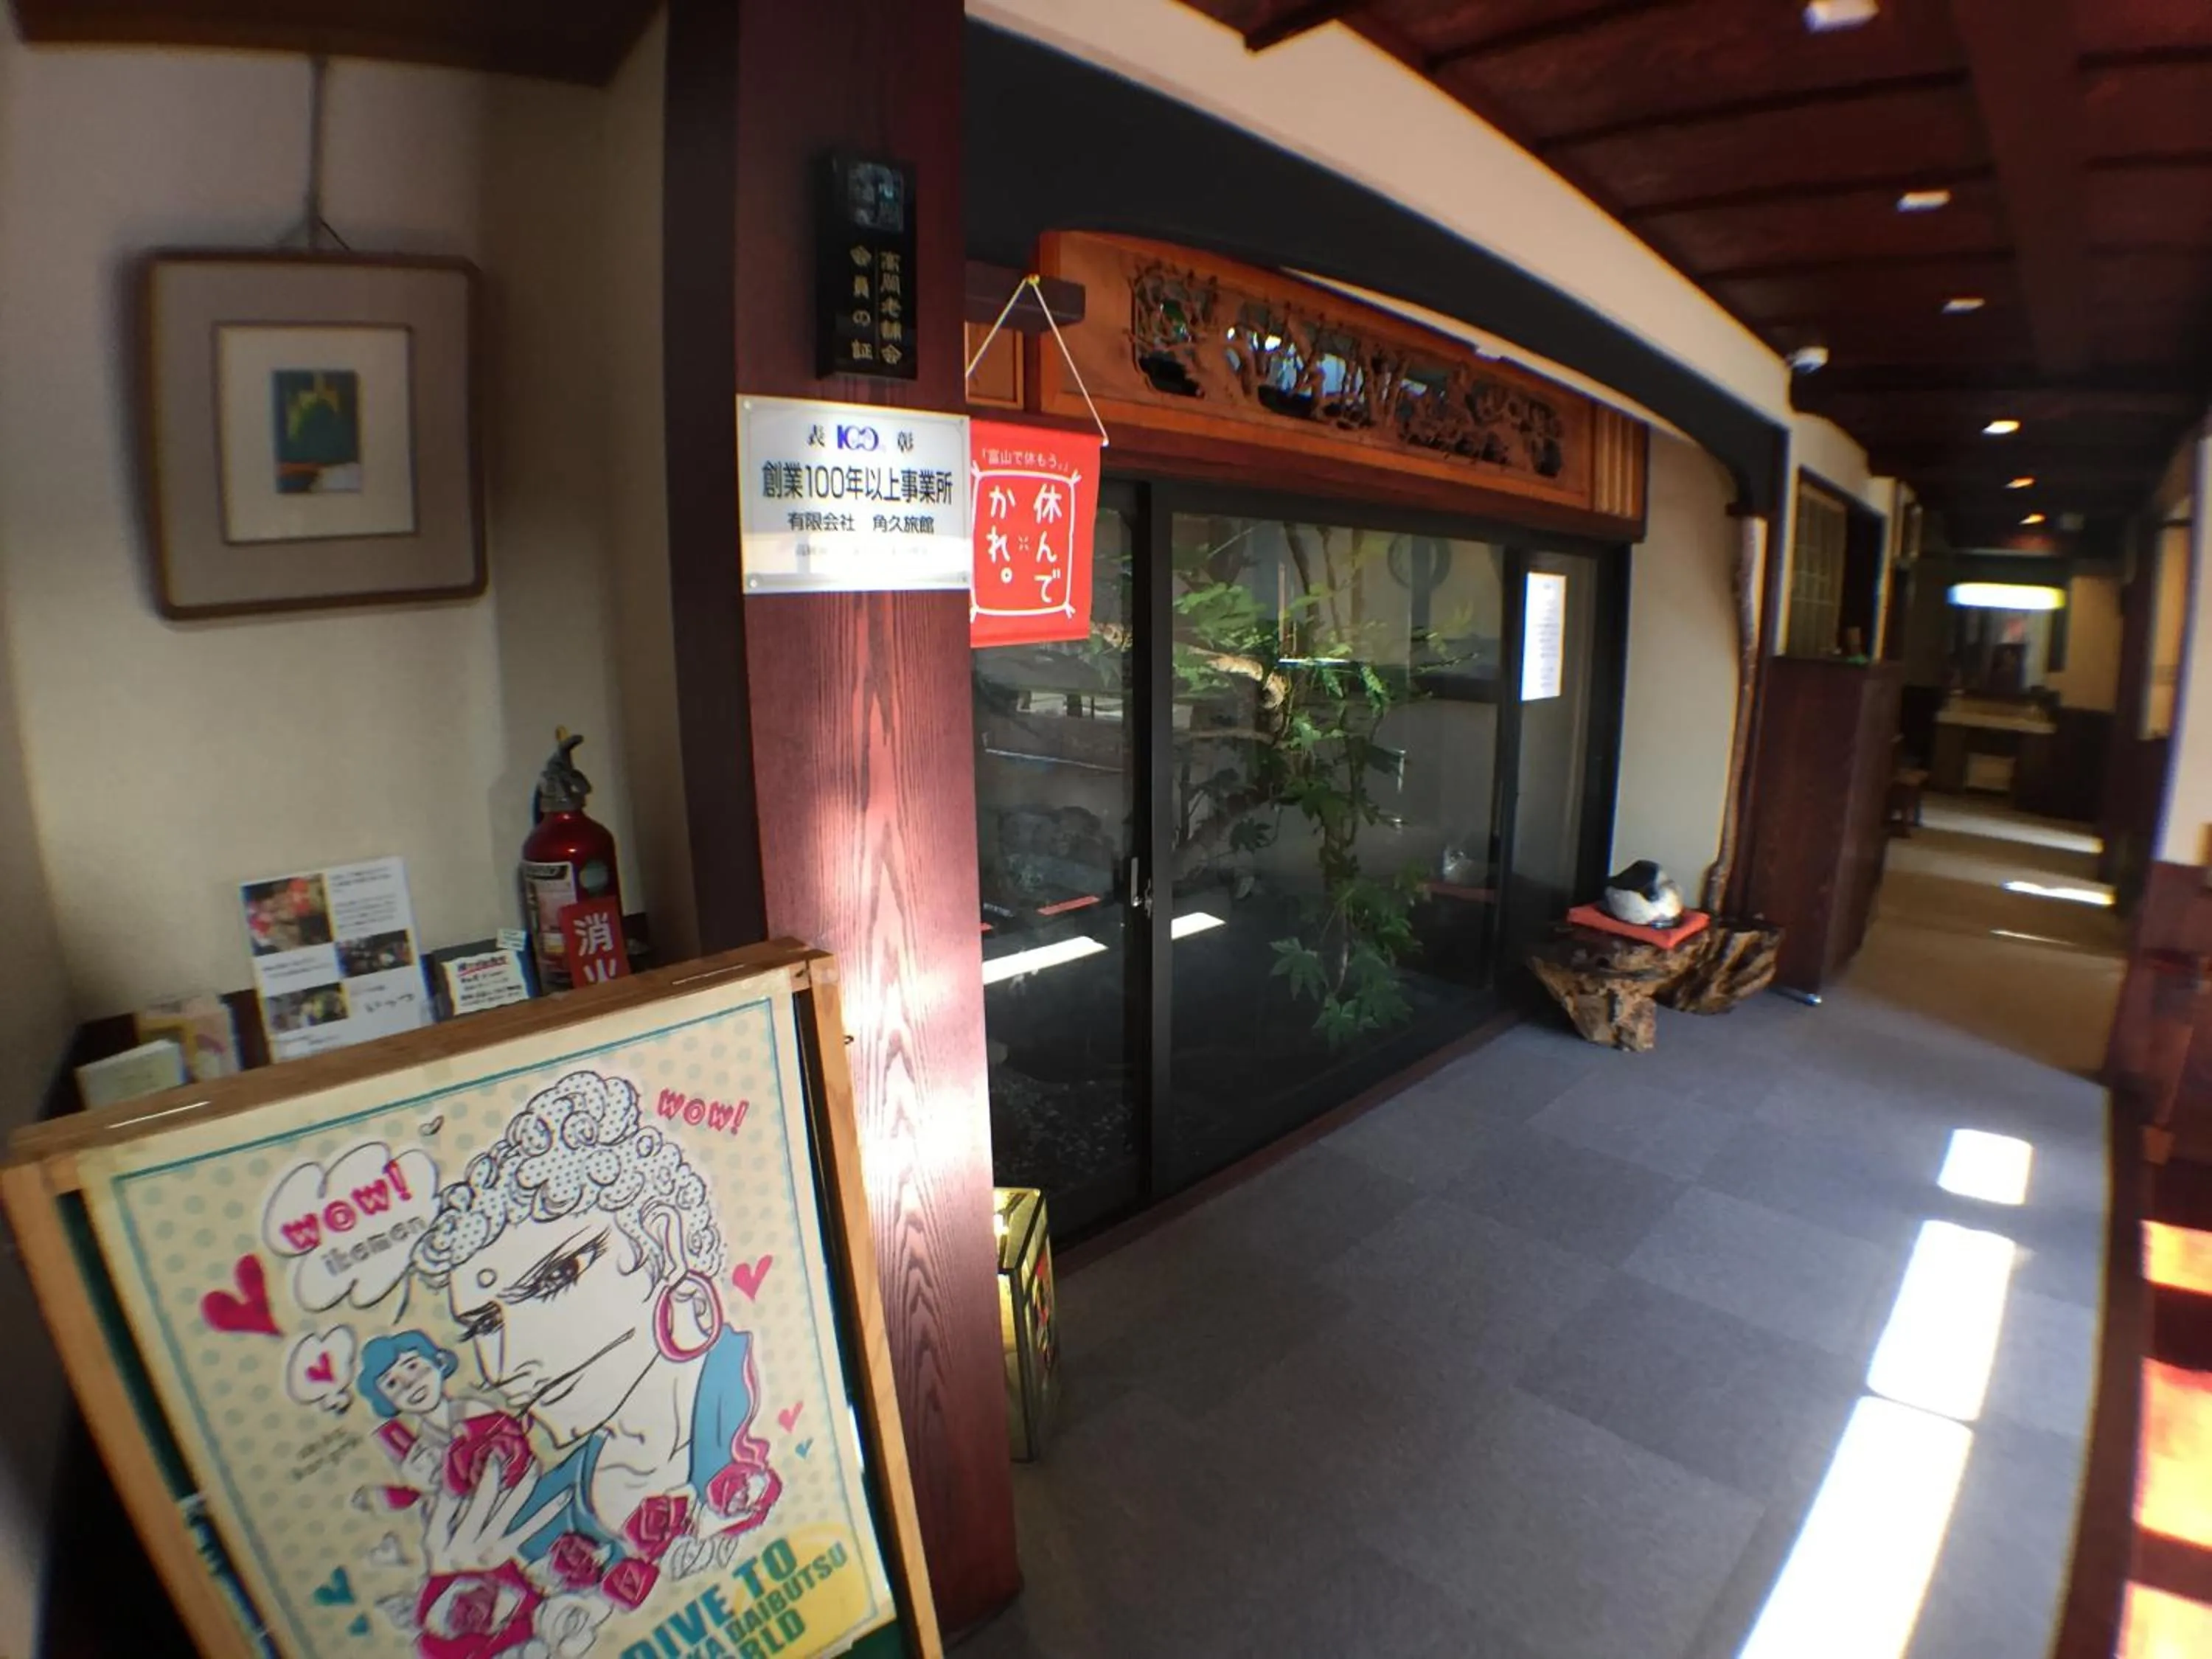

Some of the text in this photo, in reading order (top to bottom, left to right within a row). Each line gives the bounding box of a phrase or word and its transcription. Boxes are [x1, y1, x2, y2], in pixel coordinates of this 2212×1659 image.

[762, 459, 953, 504] 創業100年以上事業所
[787, 511, 934, 535] 有限会社 角久旅館
[1033, 483, 1062, 603] 休んで
[726, 1540, 849, 1645] DAIBUTSU
[732, 1537, 798, 1600] TO
